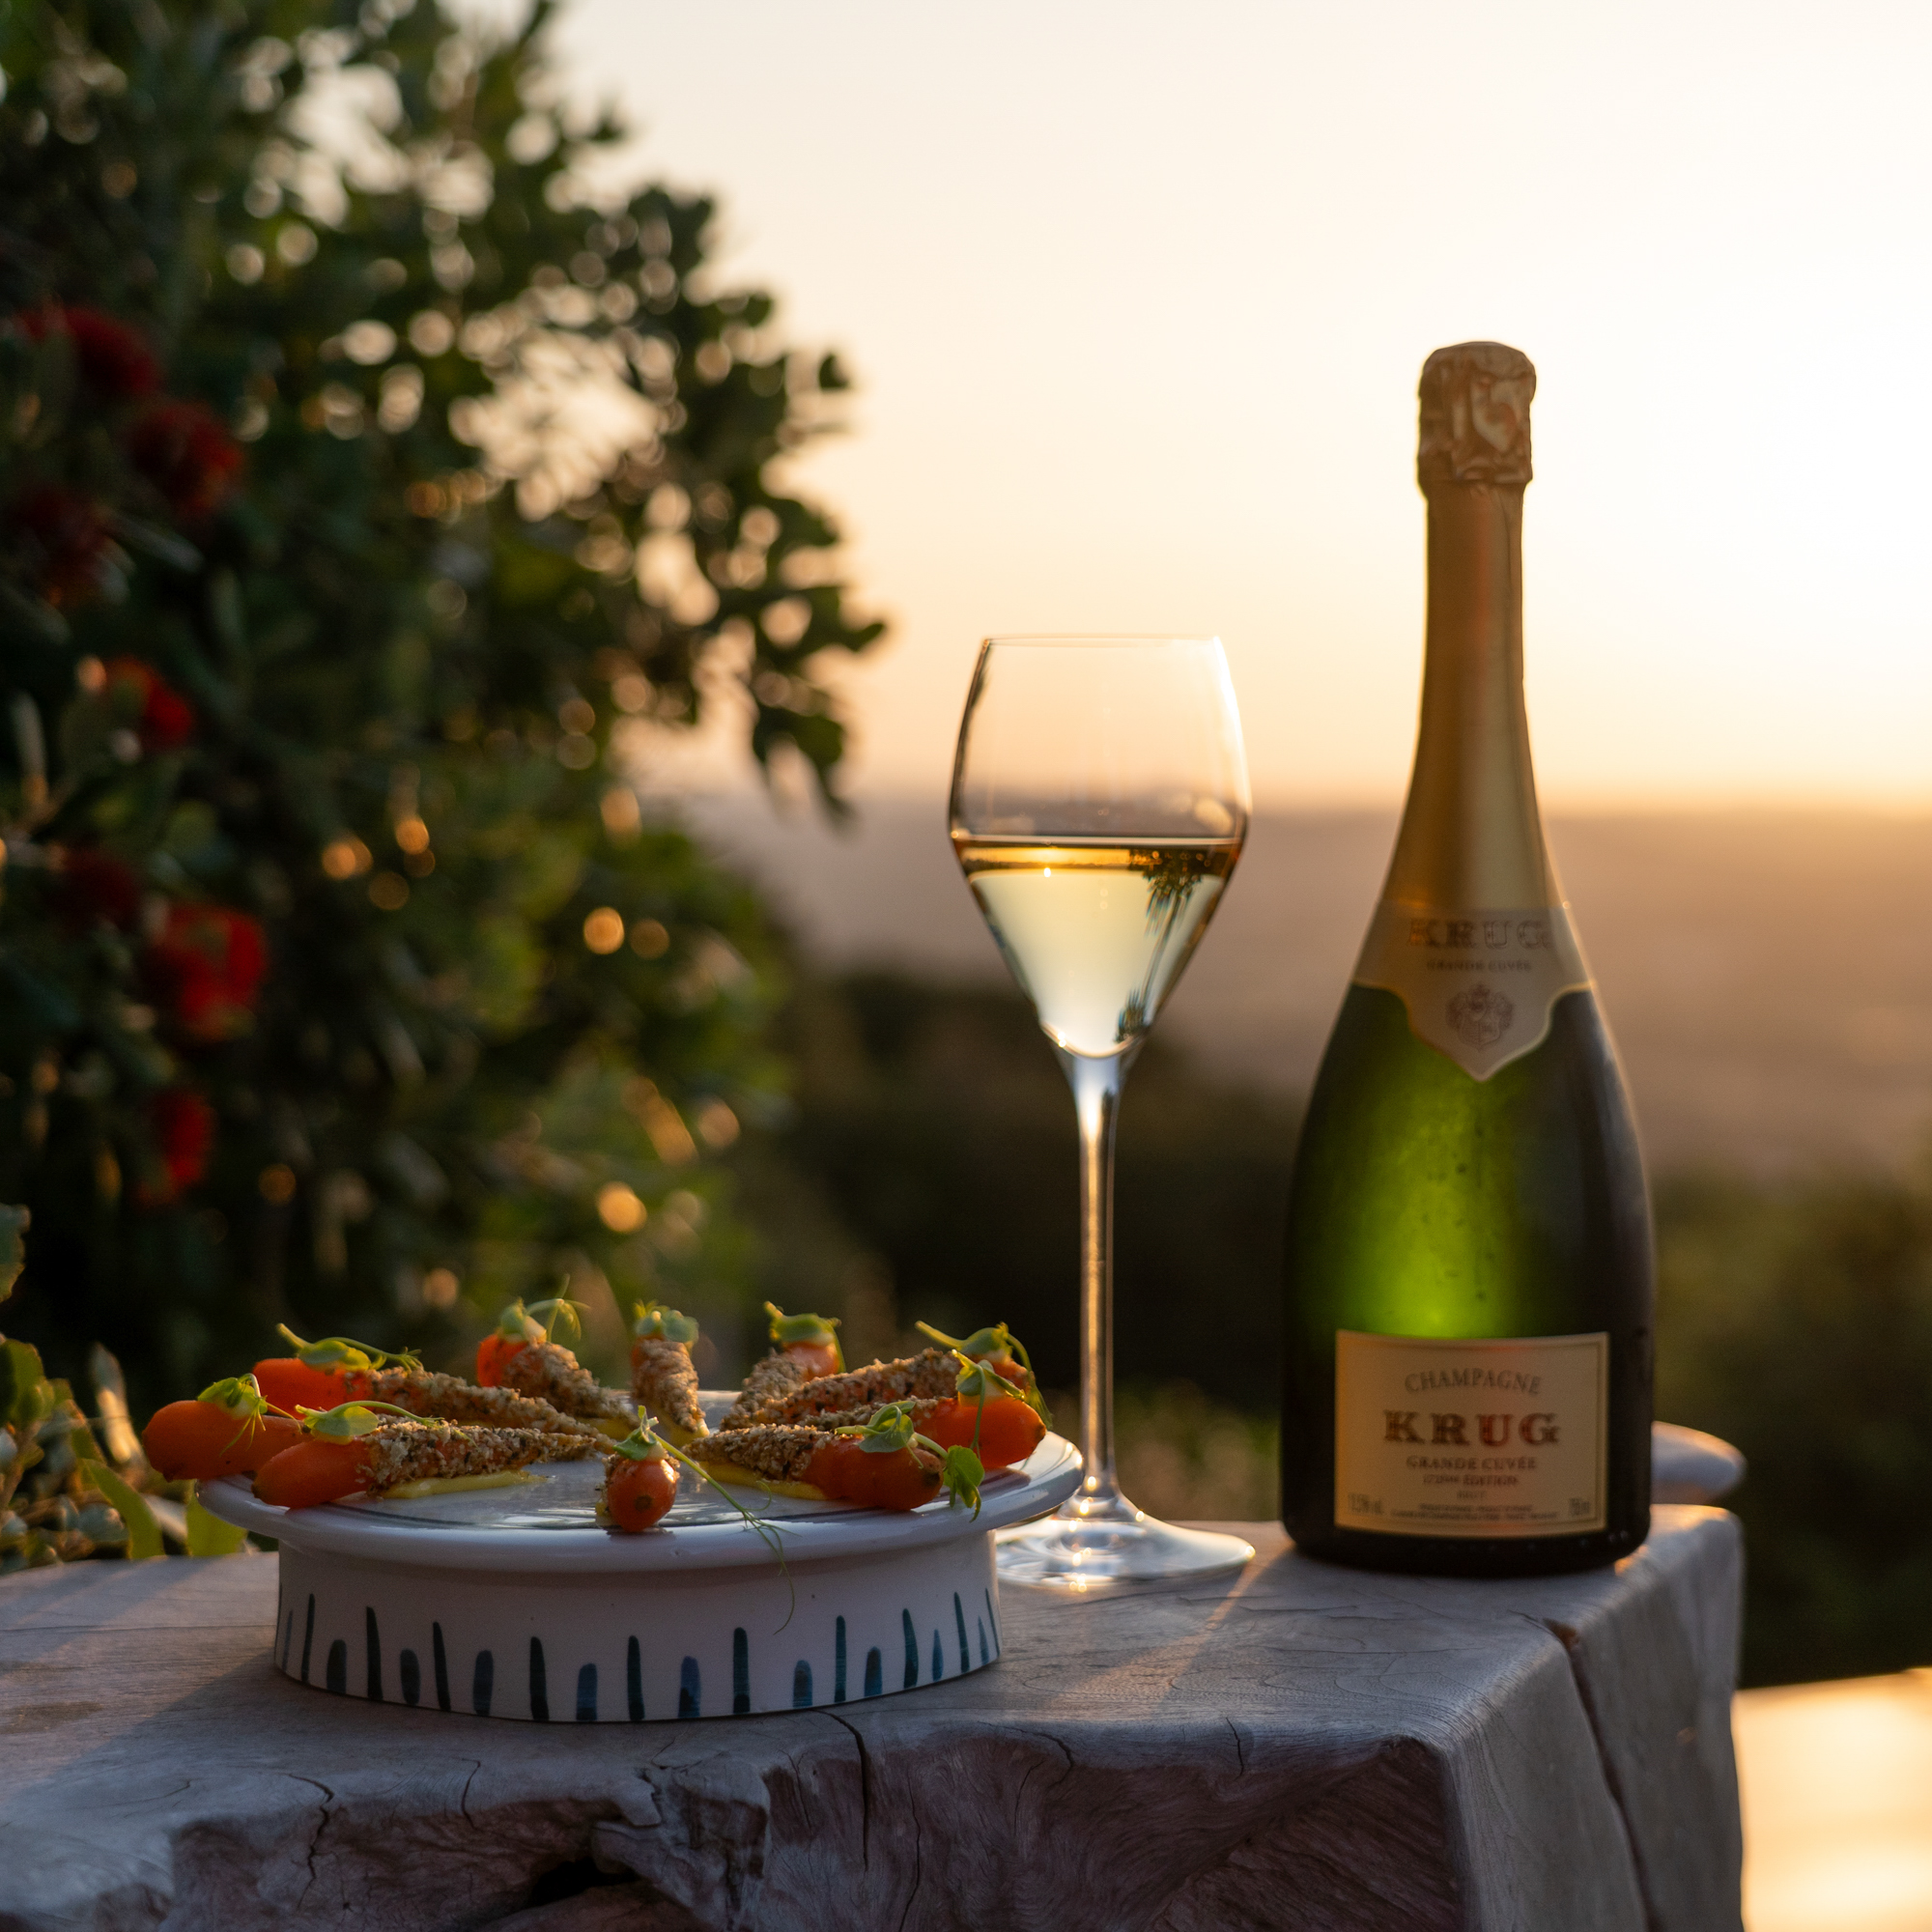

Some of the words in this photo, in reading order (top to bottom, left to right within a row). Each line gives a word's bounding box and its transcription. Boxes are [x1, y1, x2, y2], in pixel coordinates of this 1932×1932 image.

[1406, 920, 1553, 950] KRUG
[1404, 1367, 1543, 1395] CHAMPAGNE
[1383, 1409, 1560, 1447] KRUG
[1406, 1455, 1478, 1470] GRANDE
